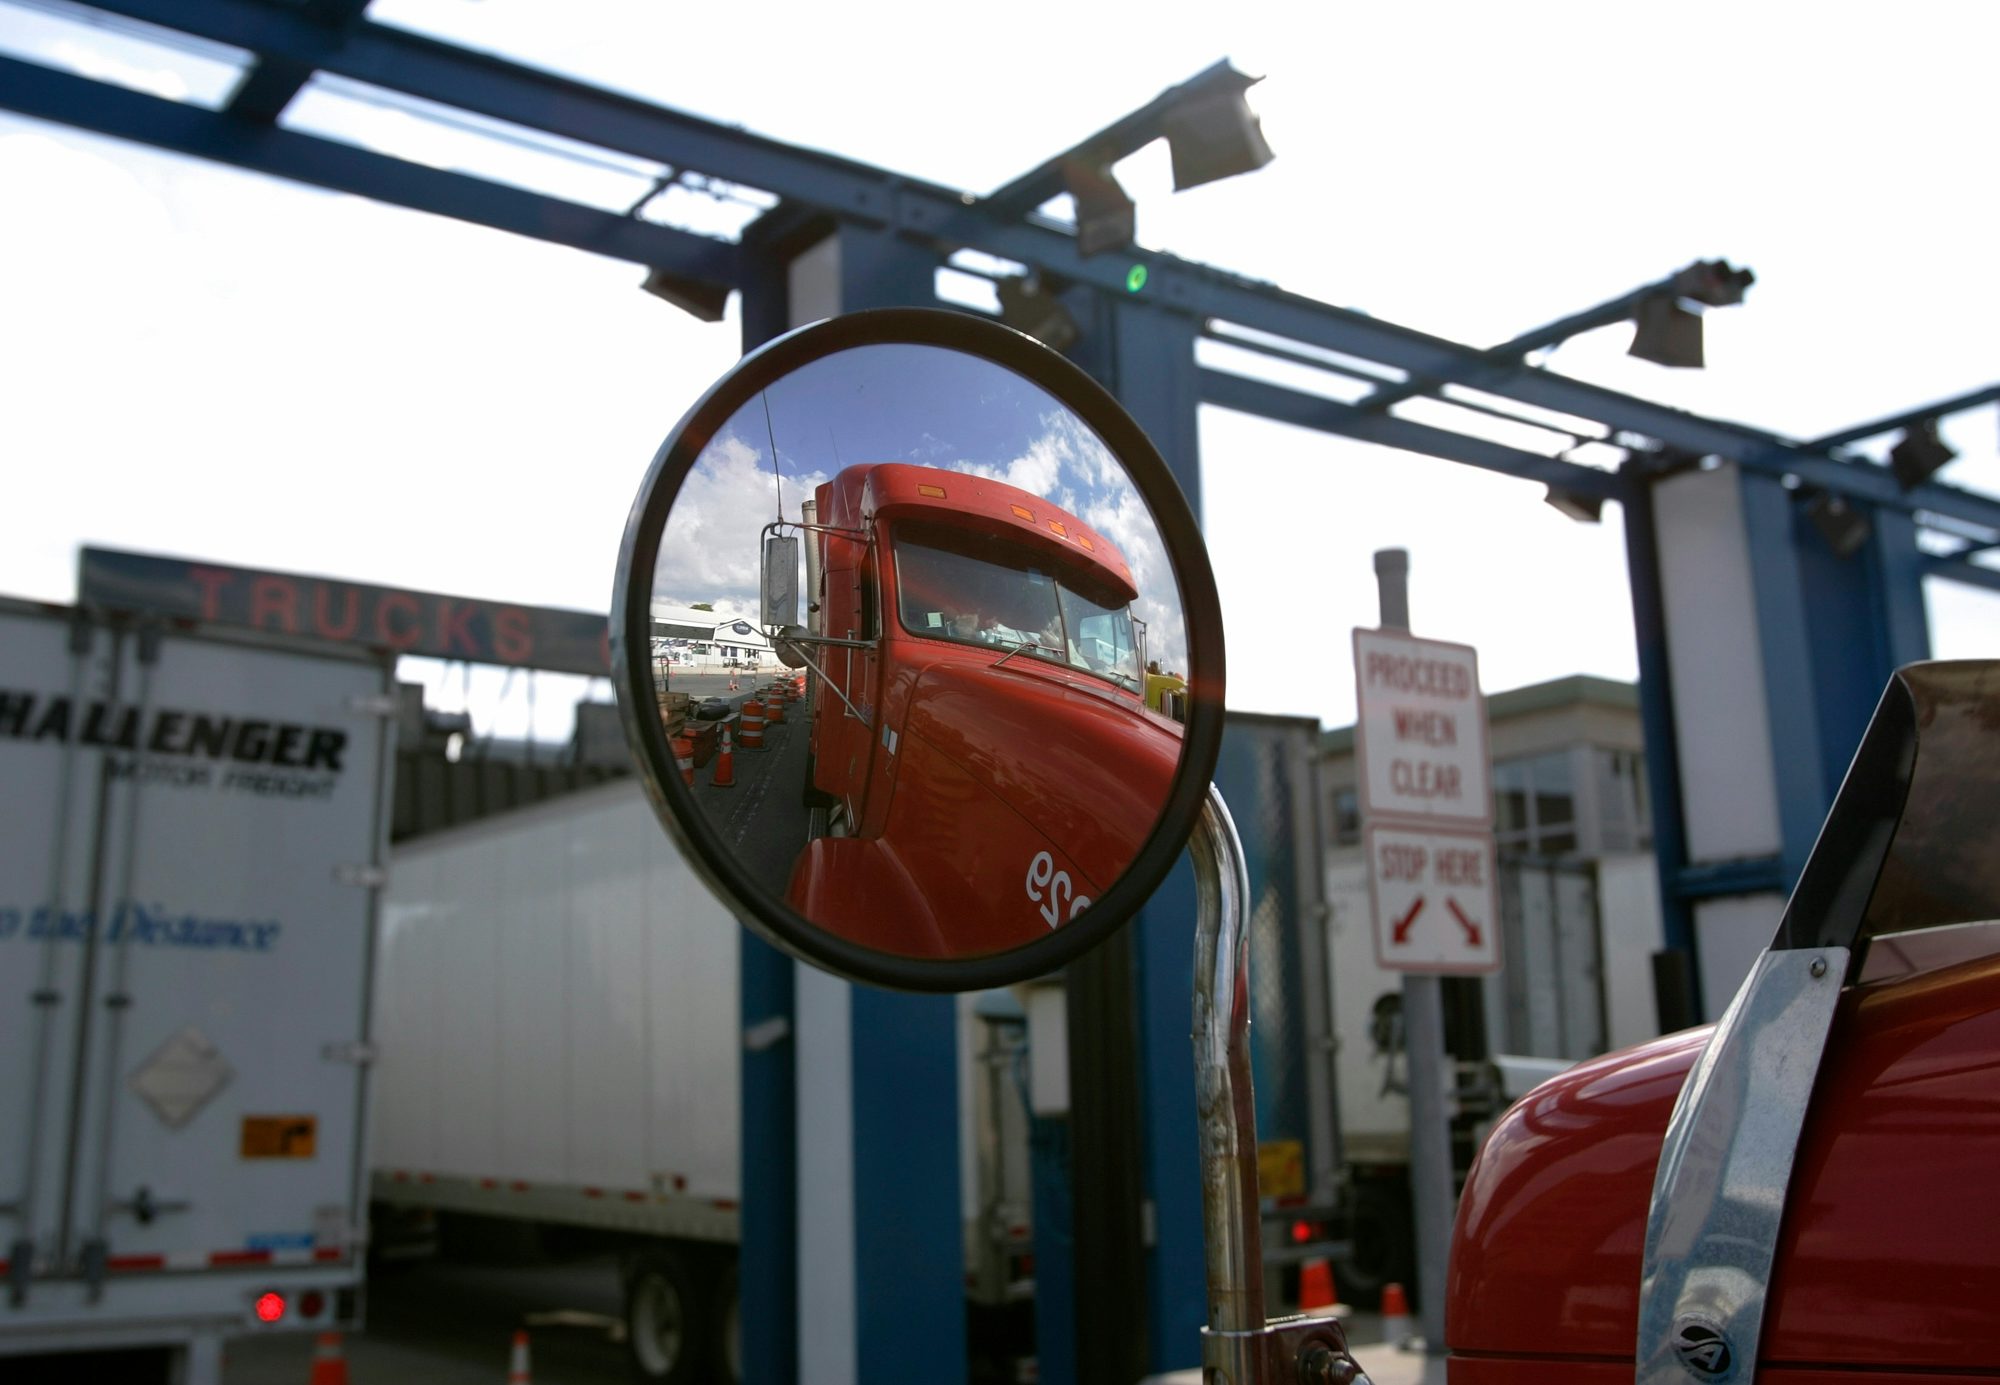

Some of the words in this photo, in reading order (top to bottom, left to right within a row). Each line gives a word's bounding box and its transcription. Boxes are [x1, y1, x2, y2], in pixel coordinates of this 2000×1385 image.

[192, 569, 534, 661] TRUCKS
[1367, 653, 1469, 697] PROCEED
[1394, 709, 1457, 747] WHEN
[1391, 760, 1461, 799] CLEAR
[1381, 845, 1428, 880] STOP
[1436, 849, 1483, 887] HERE
